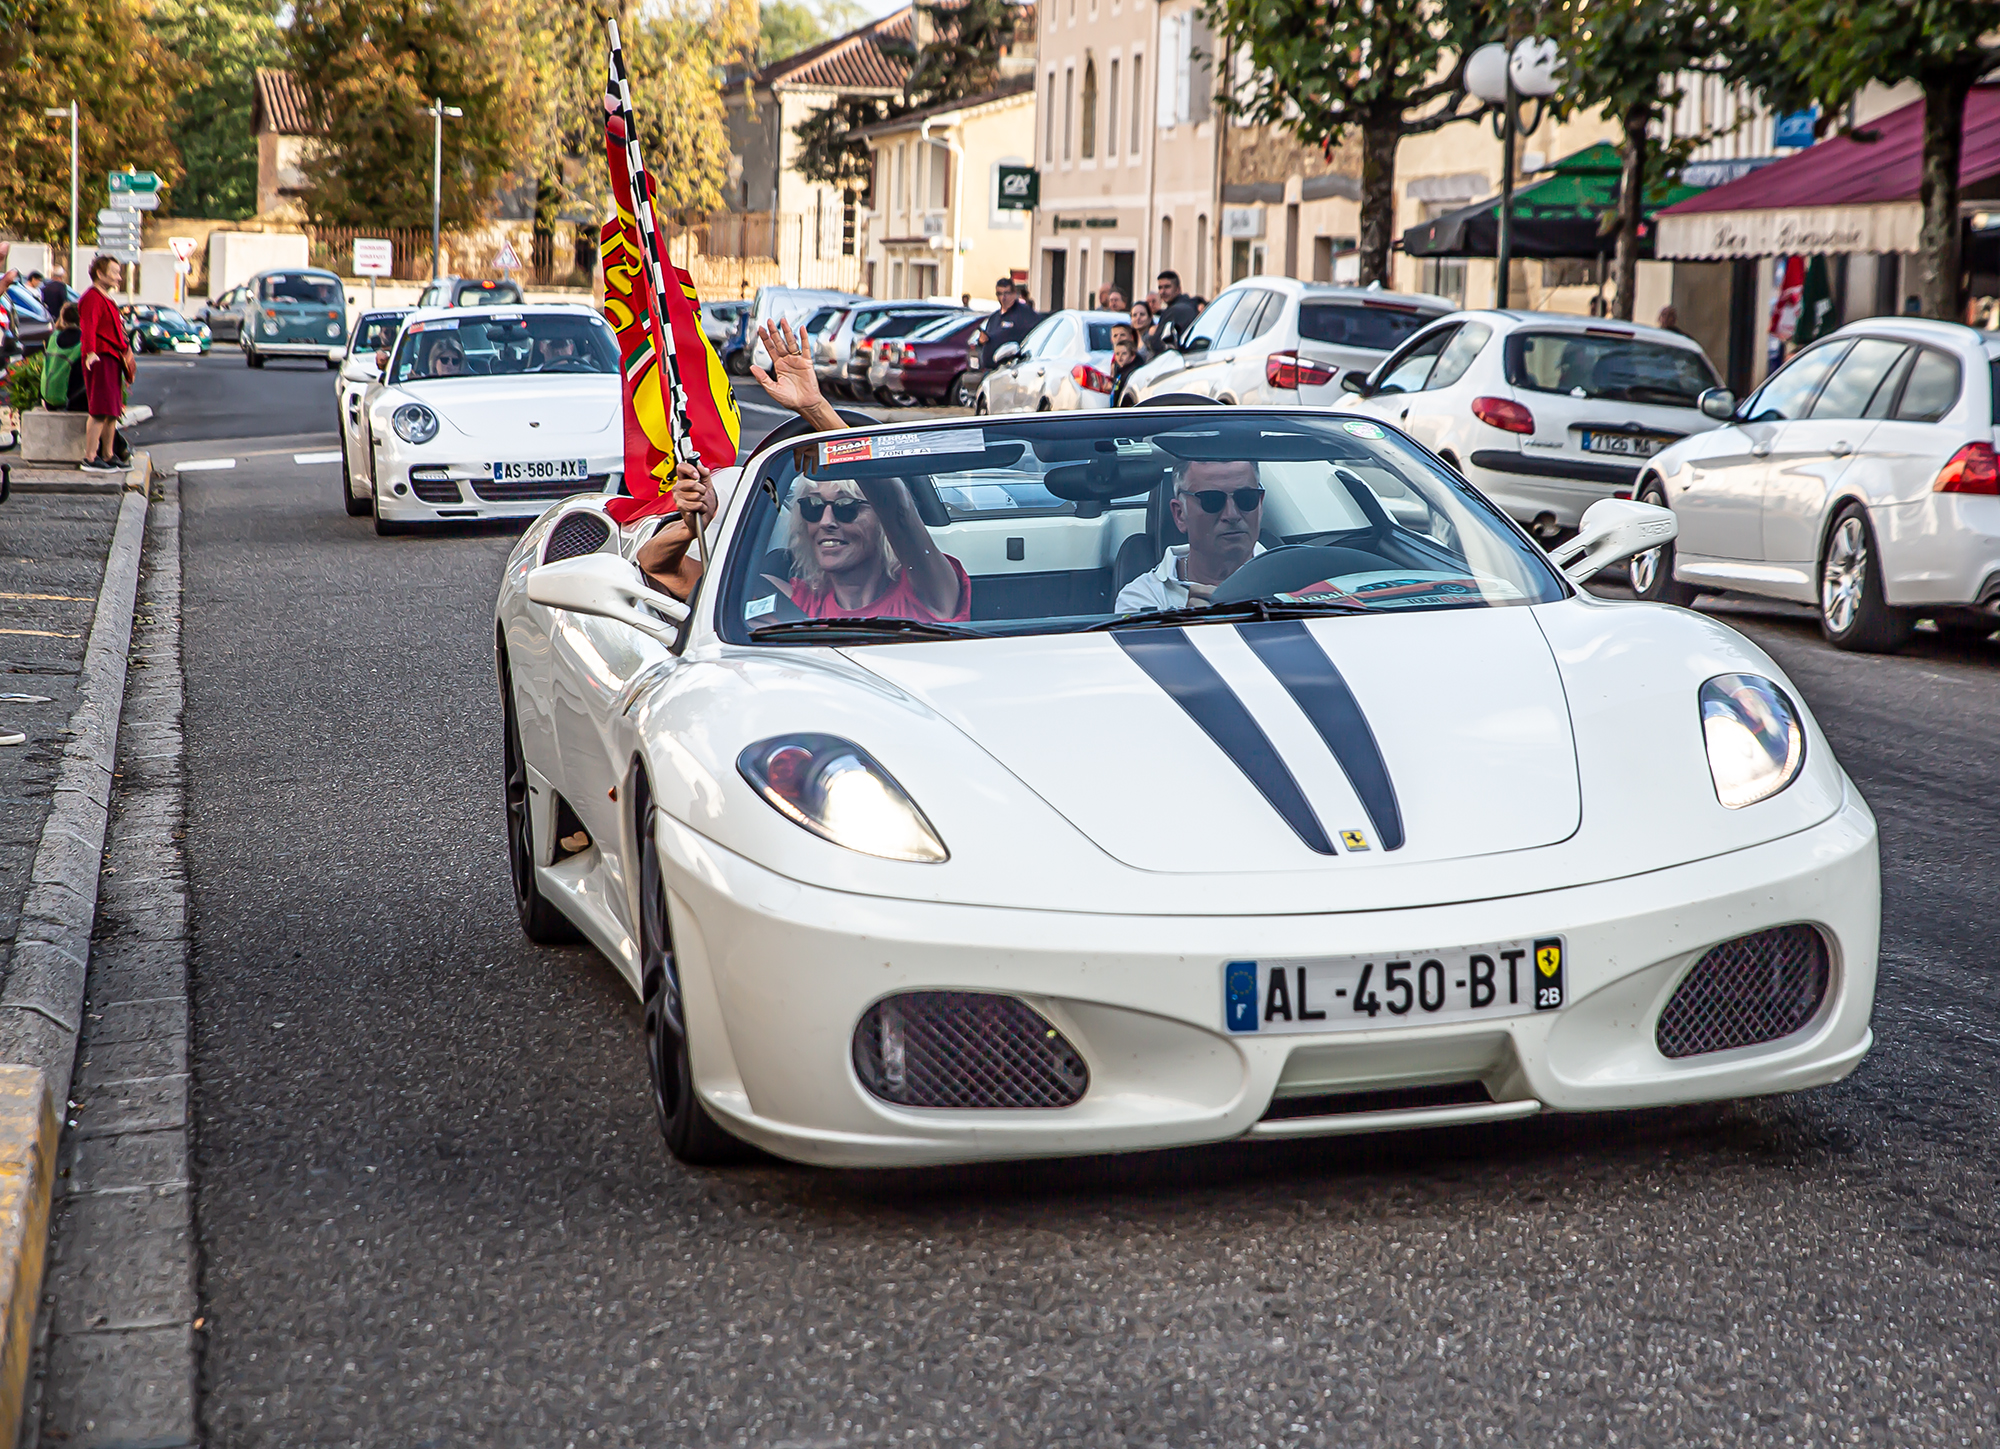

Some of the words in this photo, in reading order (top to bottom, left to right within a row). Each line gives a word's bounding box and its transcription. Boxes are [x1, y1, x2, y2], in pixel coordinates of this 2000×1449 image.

[823, 439, 873, 454] Classic
[505, 461, 577, 478] AS-580-AX
[1264, 949, 1526, 1022] AL-450-BT
[1539, 986, 1561, 1006] 2B
